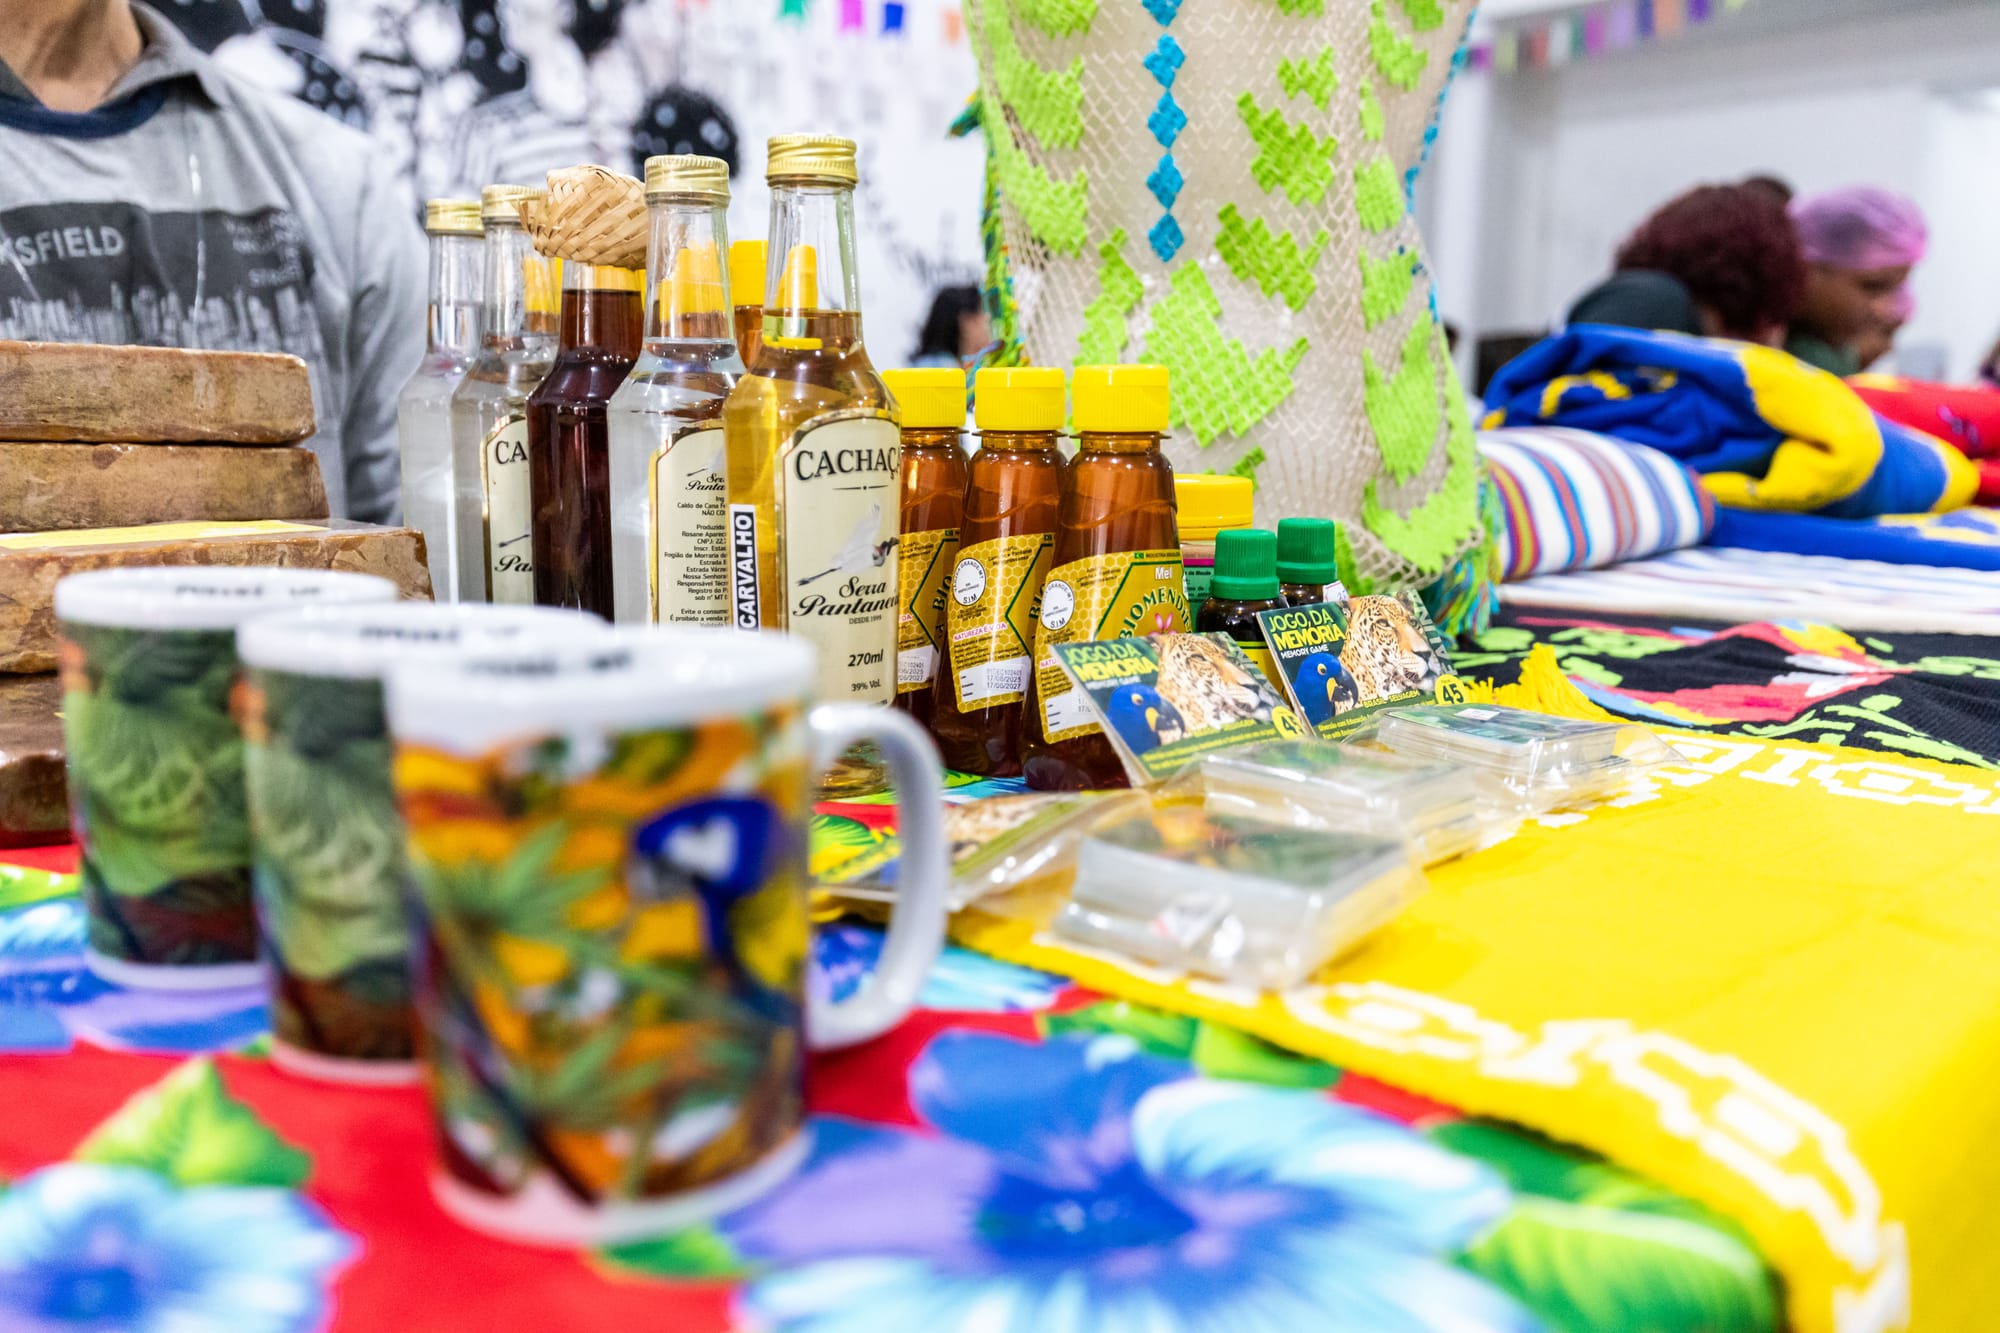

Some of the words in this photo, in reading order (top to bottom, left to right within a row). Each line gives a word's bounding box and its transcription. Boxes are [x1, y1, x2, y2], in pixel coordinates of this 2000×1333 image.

[735, 514, 757, 629] CARVALHO
[1155, 566, 1173, 580] Mel
[839, 576, 887, 598] Serra
[963, 593, 978, 604] SIM
[1050, 617, 1066, 629] SIM
[1269, 612, 1308, 632] JOGO
[1309, 608, 1334, 626] DA
[848, 648, 884, 667] 270ml
[1064, 645, 1112, 665] JOGO
[1110, 642, 1143, 659] DA
[1280, 647, 1309, 659] MEMORY
[1310, 644, 1329, 654] GAME
[851, 682, 868, 692] 39%
[1443, 683, 1465, 704] 45
